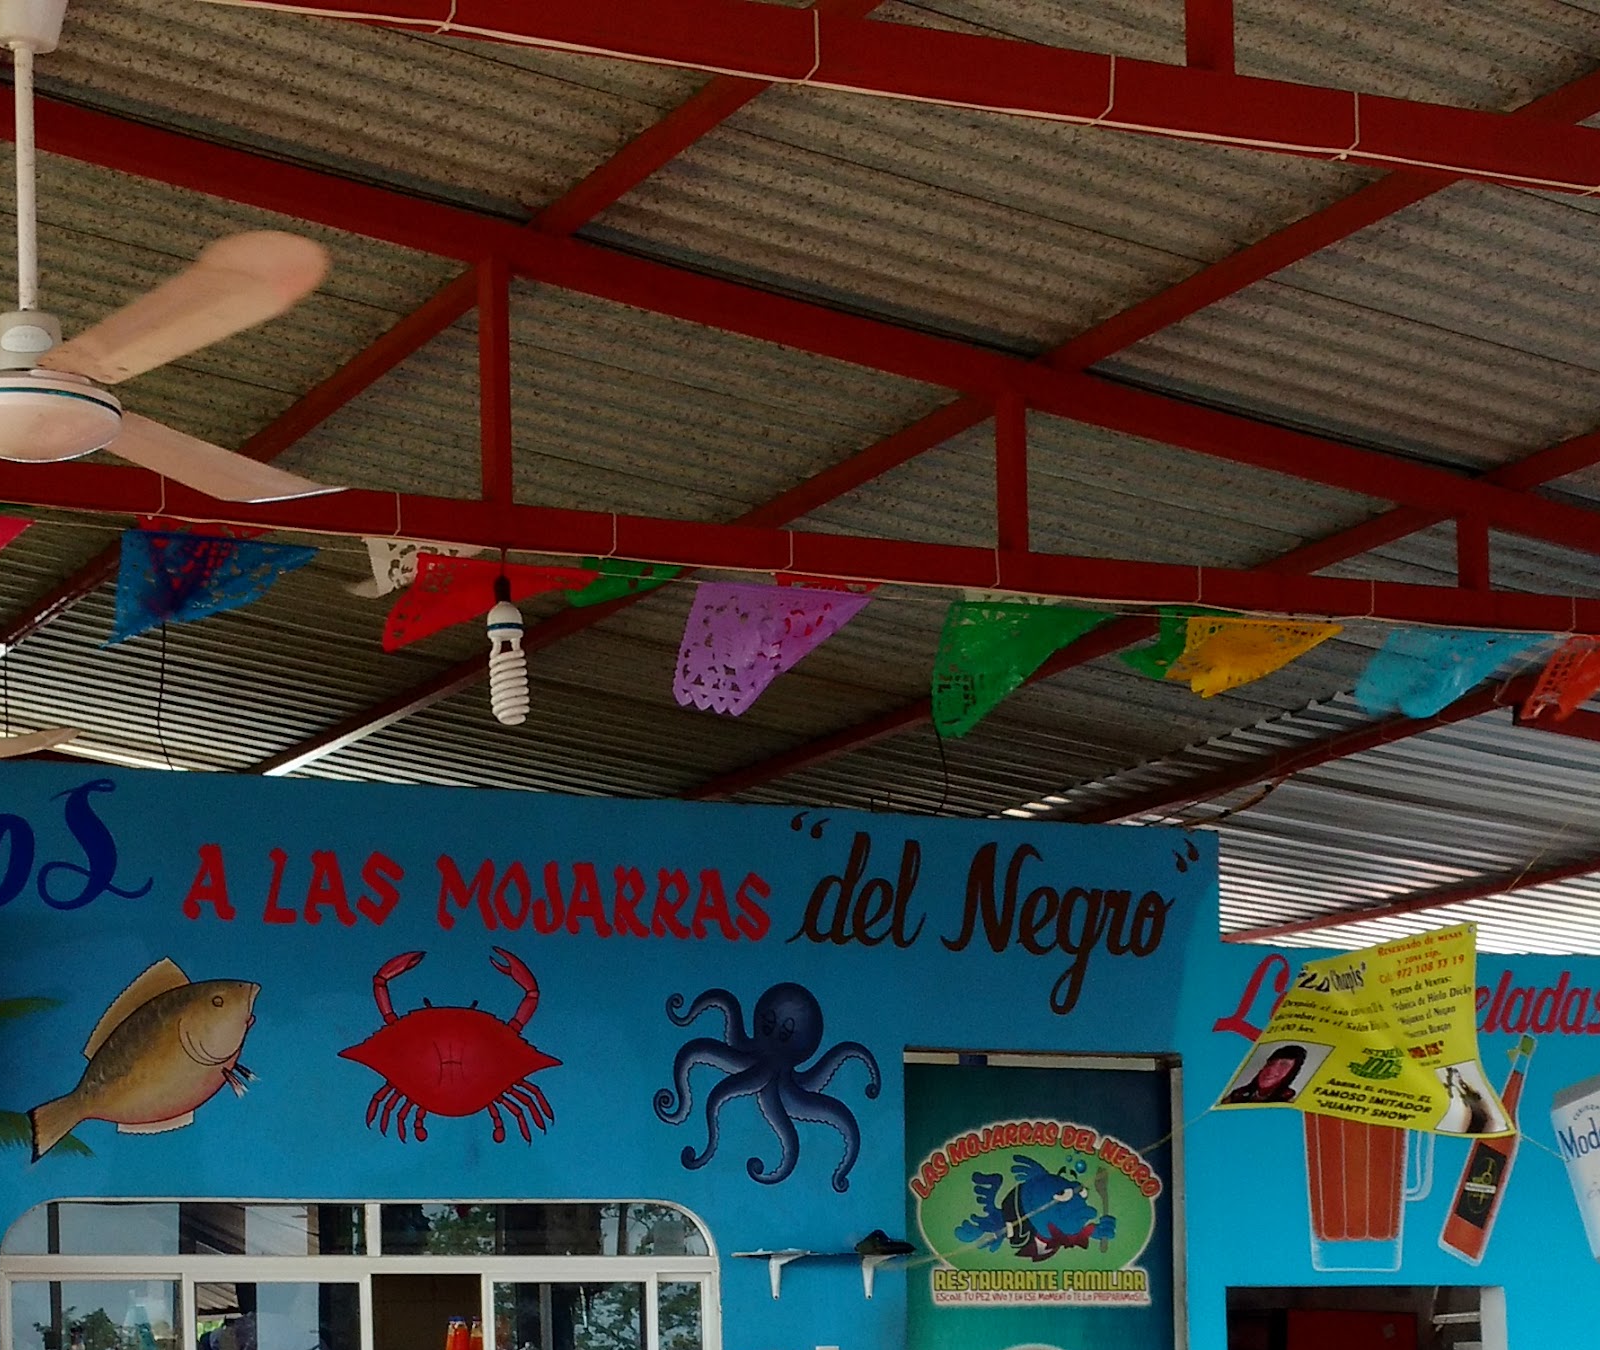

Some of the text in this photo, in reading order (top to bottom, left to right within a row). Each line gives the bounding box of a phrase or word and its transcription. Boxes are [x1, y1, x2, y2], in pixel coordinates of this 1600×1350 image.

[183, 842, 234, 922] A
[263, 847, 404, 928] LAS
[435, 854, 770, 942] MOJARRAS
[1313, 1087, 1366, 1102] FAMOSO
[911, 1122, 1162, 1199] LAS MOJARRAS DEL NEGRO
[934, 1269, 1145, 1291] RESTAURANTE FAMILIAR
